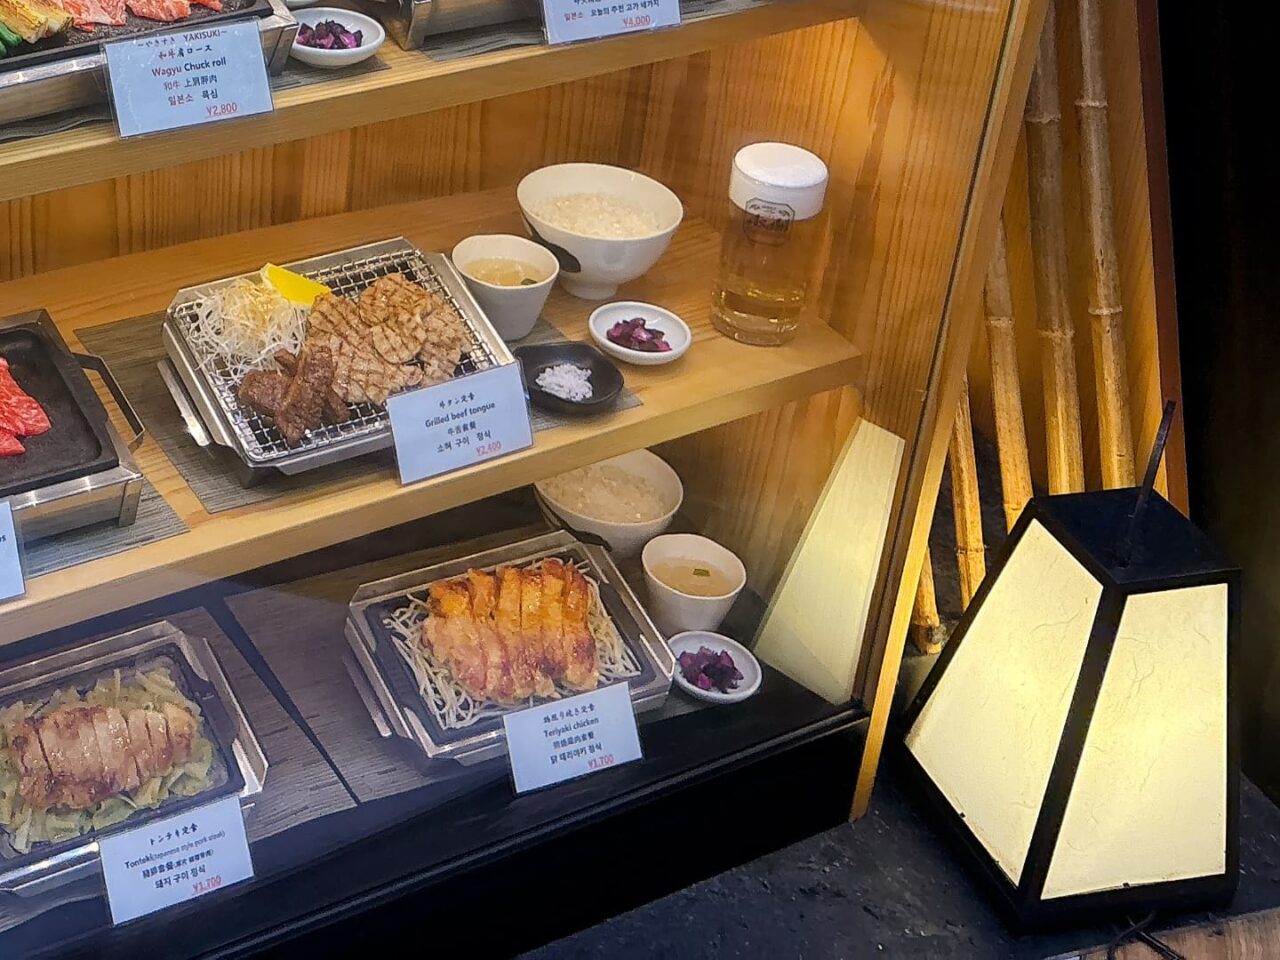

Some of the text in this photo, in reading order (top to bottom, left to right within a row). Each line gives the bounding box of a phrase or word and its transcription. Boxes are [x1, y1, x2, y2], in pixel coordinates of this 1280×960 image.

[623, 15, 651, 28] ¥4,000
[159, 45, 212, 59] 和牛肩ロース
[152, 57, 226, 79] Wagyu Chuck roll
[163, 80, 180, 92] 和牛
[168, 93, 194, 106] 일본소
[206, 102, 237, 117] ¥2,800
[425, 403, 495, 428] Grilled beef tongue
[455, 436, 470, 447] 구이
[544, 718, 599, 738] Teriyaki chicken
[173, 871, 189, 883] 구이
